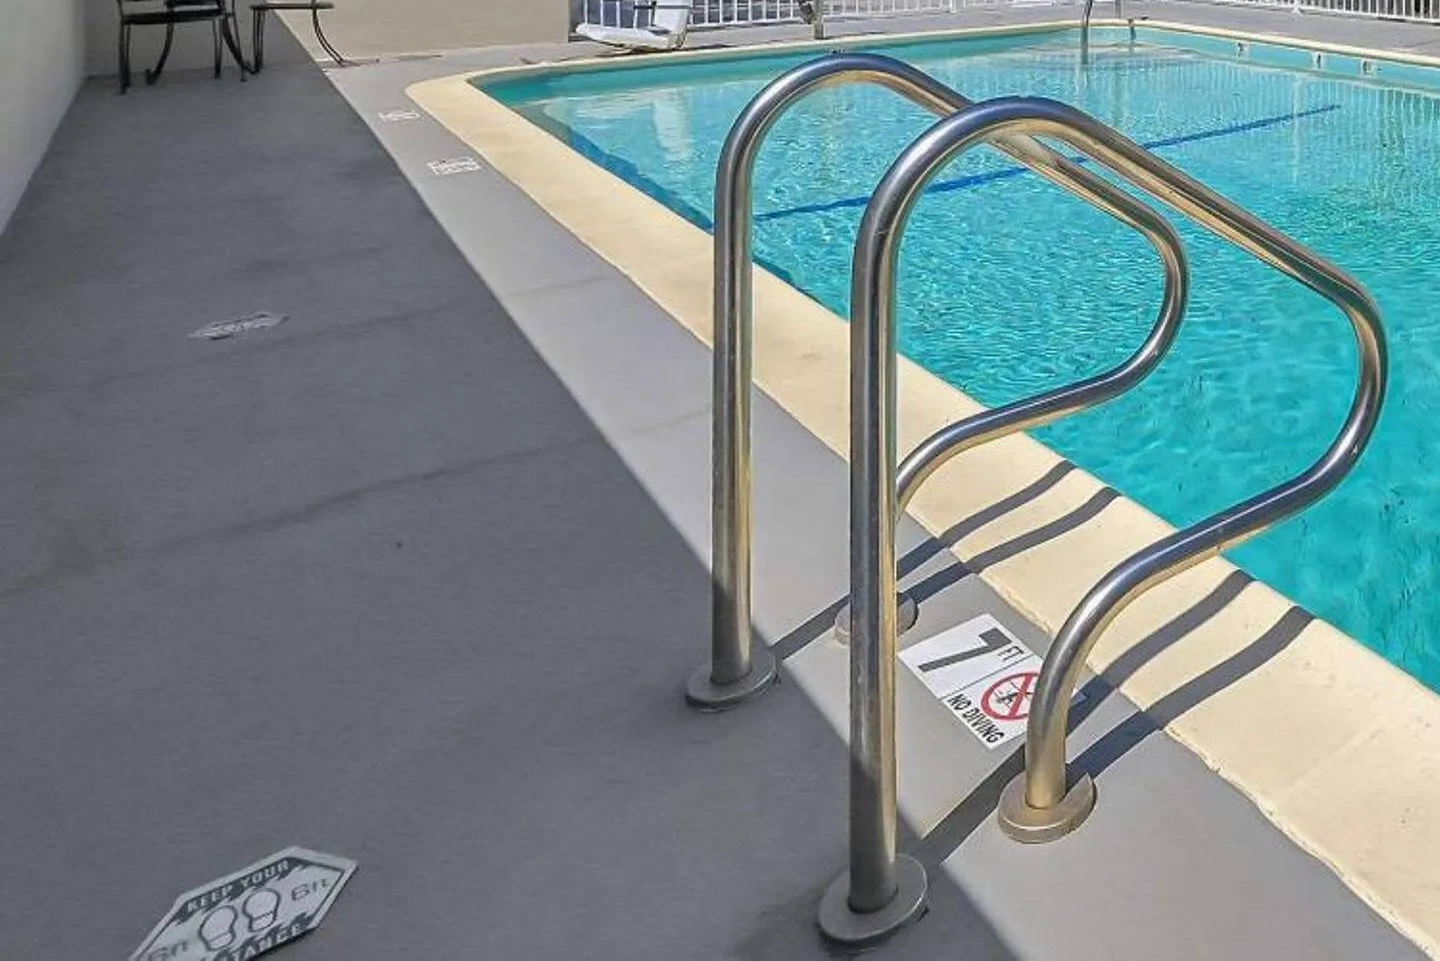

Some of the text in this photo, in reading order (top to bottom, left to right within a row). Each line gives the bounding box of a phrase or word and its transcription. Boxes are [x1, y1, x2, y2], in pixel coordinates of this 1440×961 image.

[917, 627, 1012, 672] 7
[999, 645, 1024, 662] FT
[948, 693, 1005, 744] NO DIVING
[186, 860, 290, 913] KEEP YOUR
